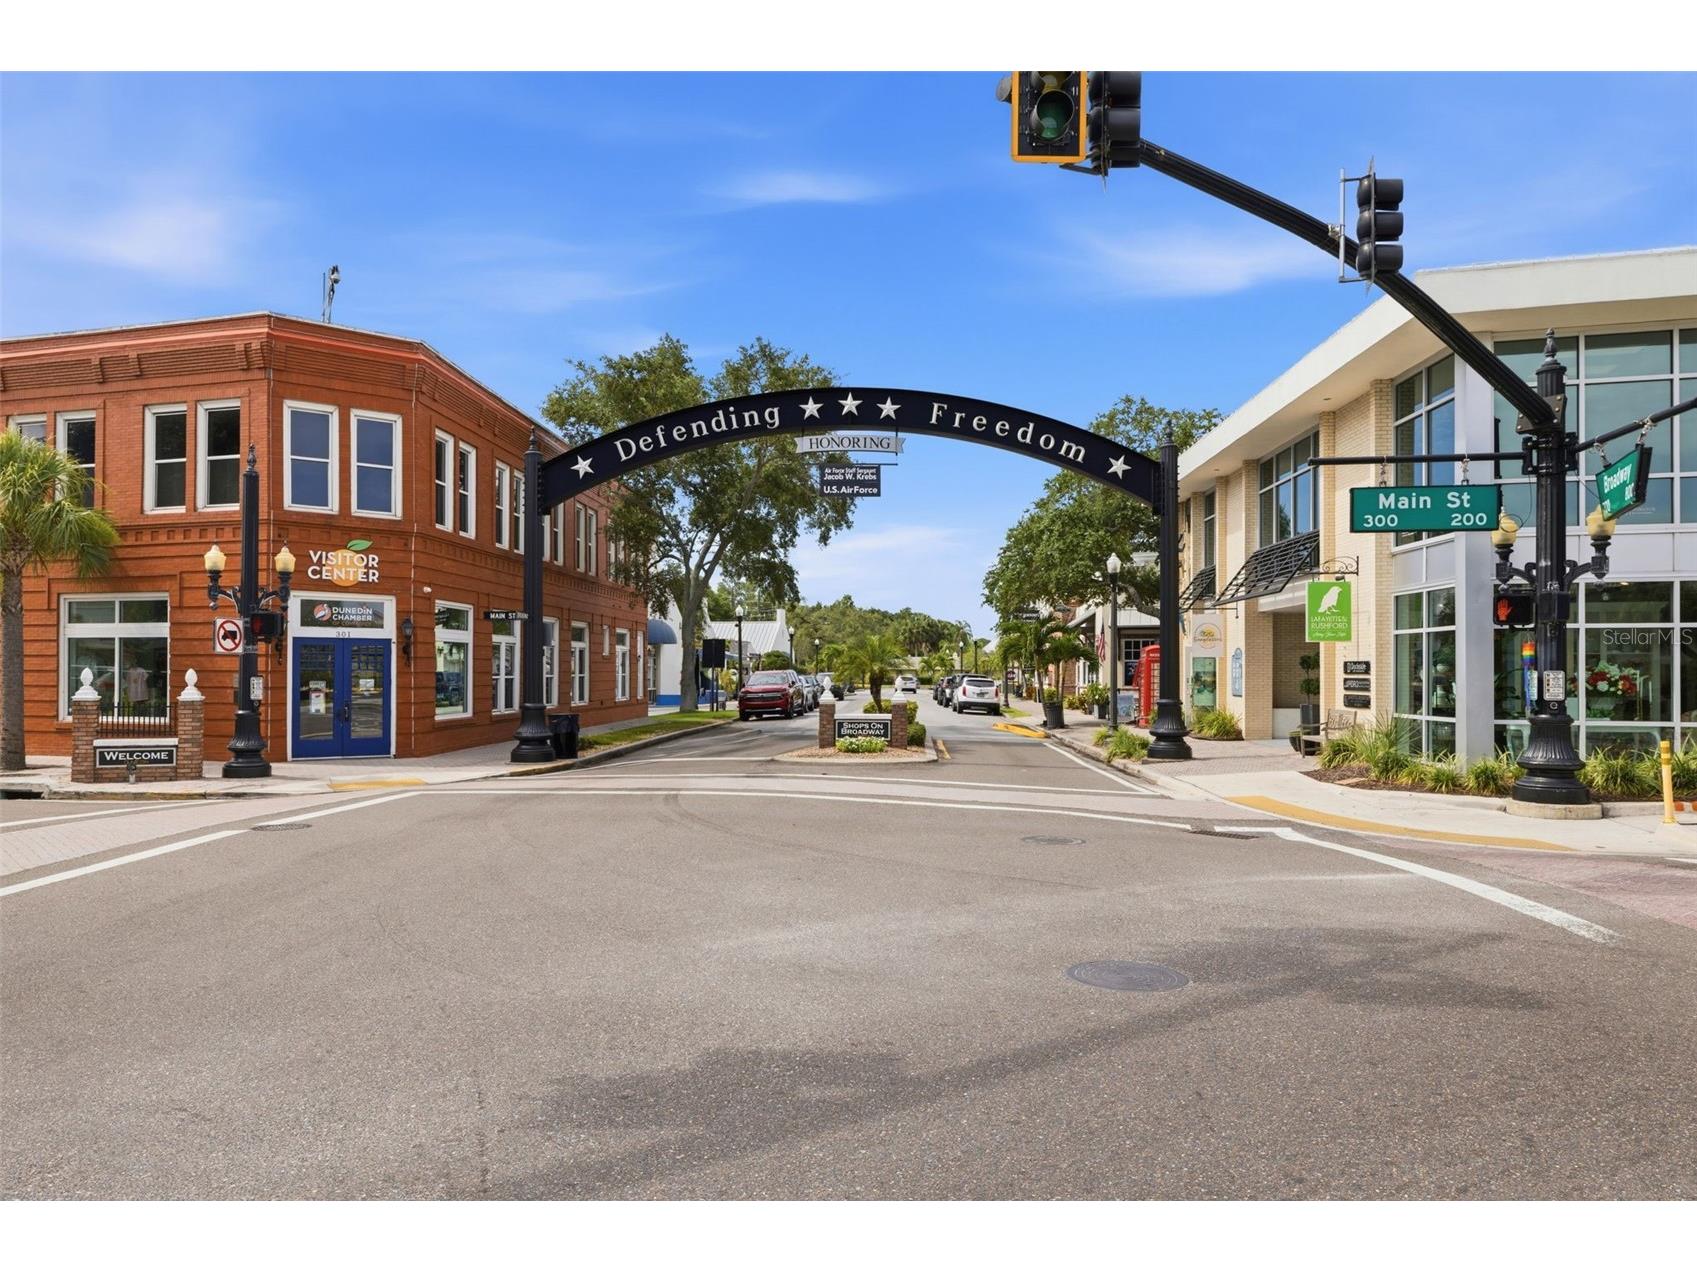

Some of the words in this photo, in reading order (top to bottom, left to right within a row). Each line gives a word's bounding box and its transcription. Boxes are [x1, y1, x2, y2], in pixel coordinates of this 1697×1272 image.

[614, 406, 780, 462] Defending
[929, 402, 1087, 463] Freedom
[808, 436, 891, 450] HONORING
[1378, 493, 1431, 509] Main
[1446, 491, 1471, 508] St
[1363, 515, 1398, 528] 300
[1451, 513, 1487, 526] 200
[309, 550, 379, 568] VISITOR
[308, 566, 379, 583] CENTER
[332, 614, 373, 622] CHAMBER
[104, 751, 169, 761] WELCOME
